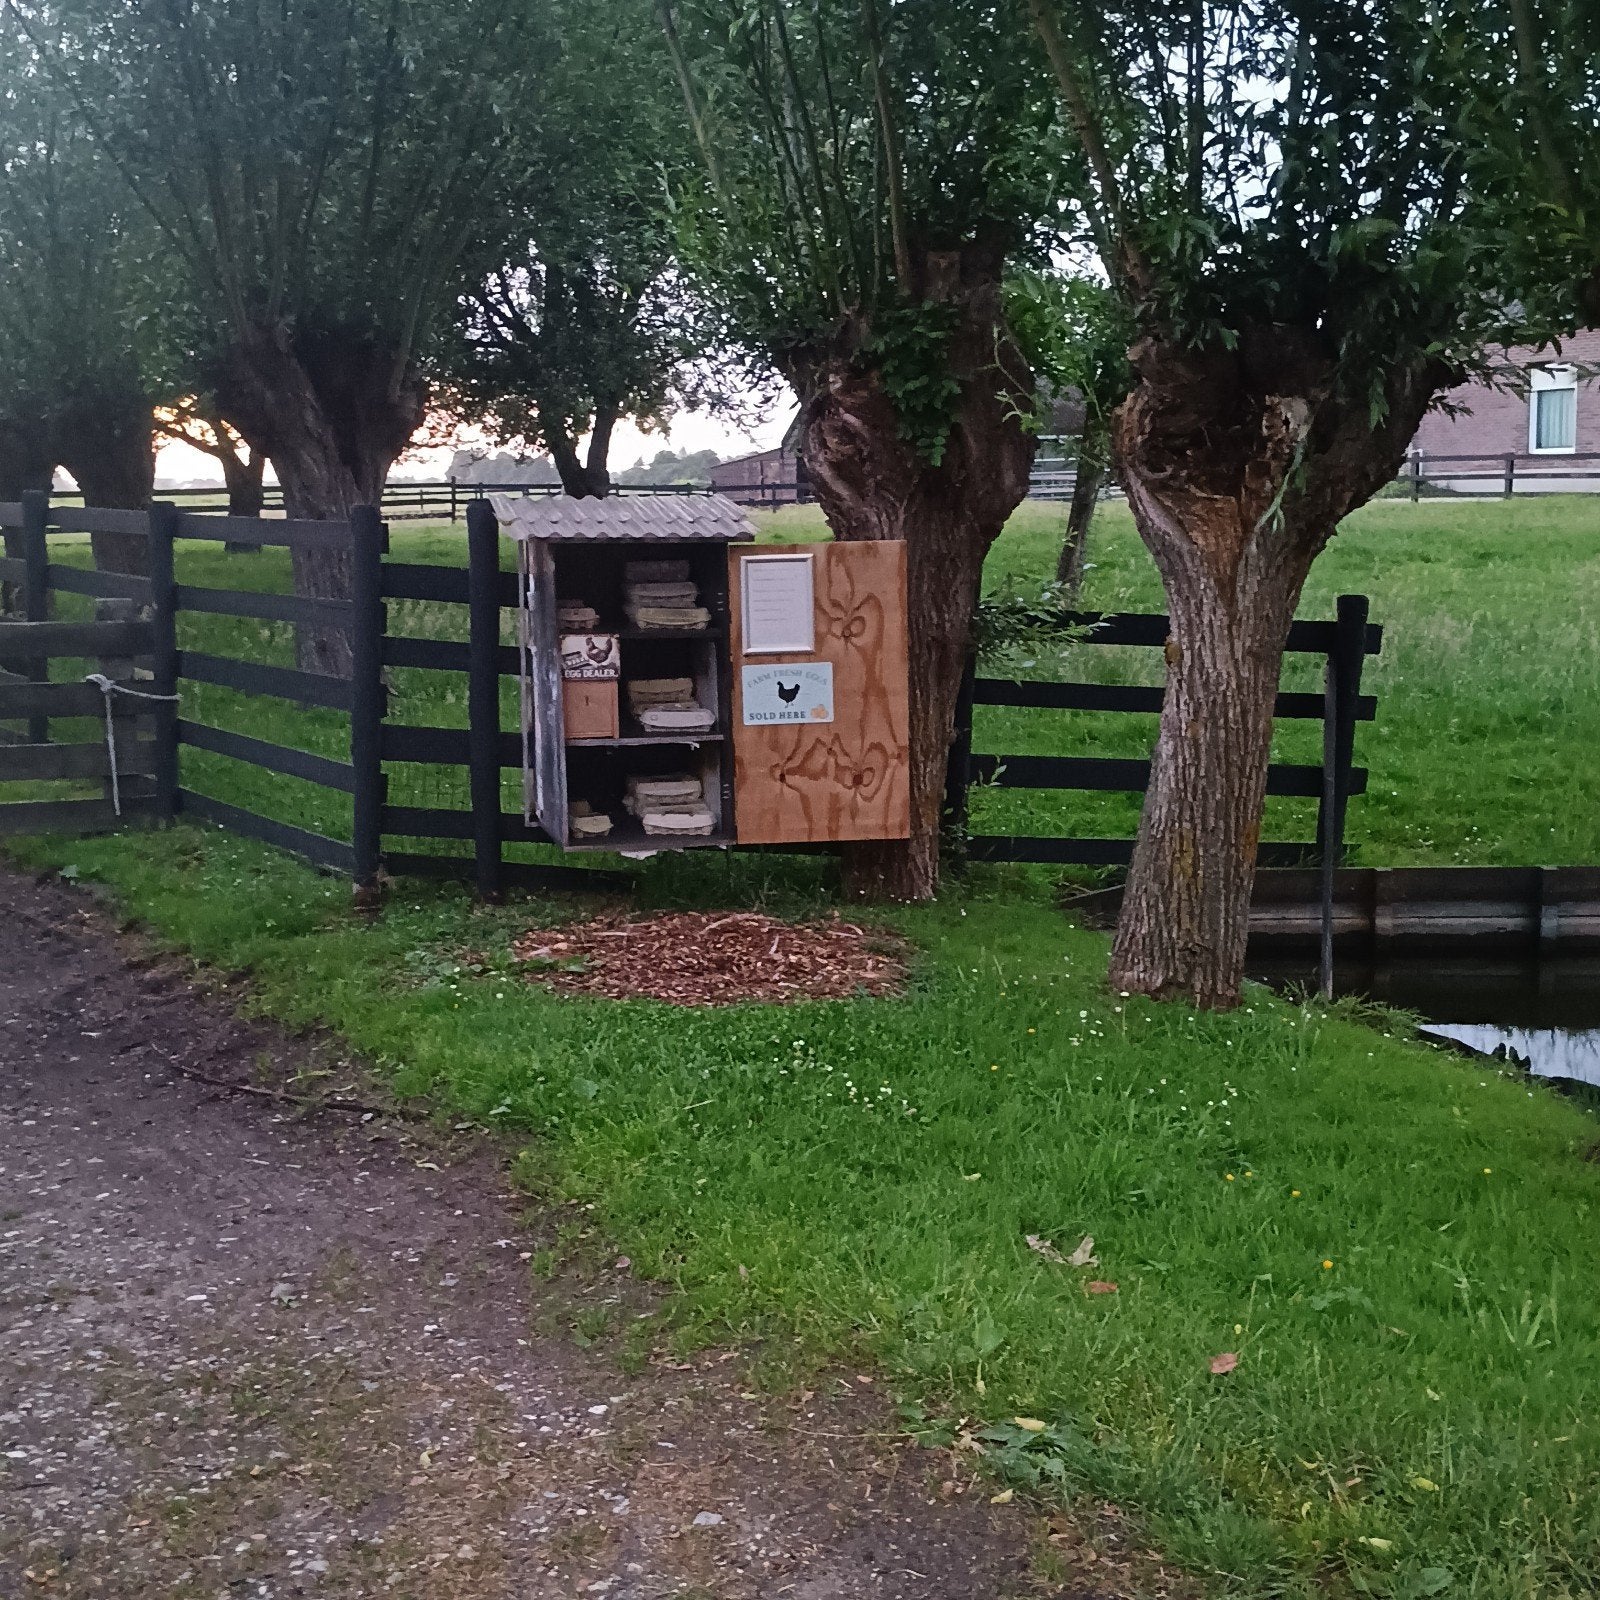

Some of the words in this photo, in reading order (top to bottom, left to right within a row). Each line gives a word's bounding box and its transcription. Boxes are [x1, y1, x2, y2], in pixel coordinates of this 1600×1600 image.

[748, 673, 771, 688] FARM
[774, 669, 802, 677] FRESH
[749, 712, 776, 721] SOLD
[779, 711, 806, 719] HERE
